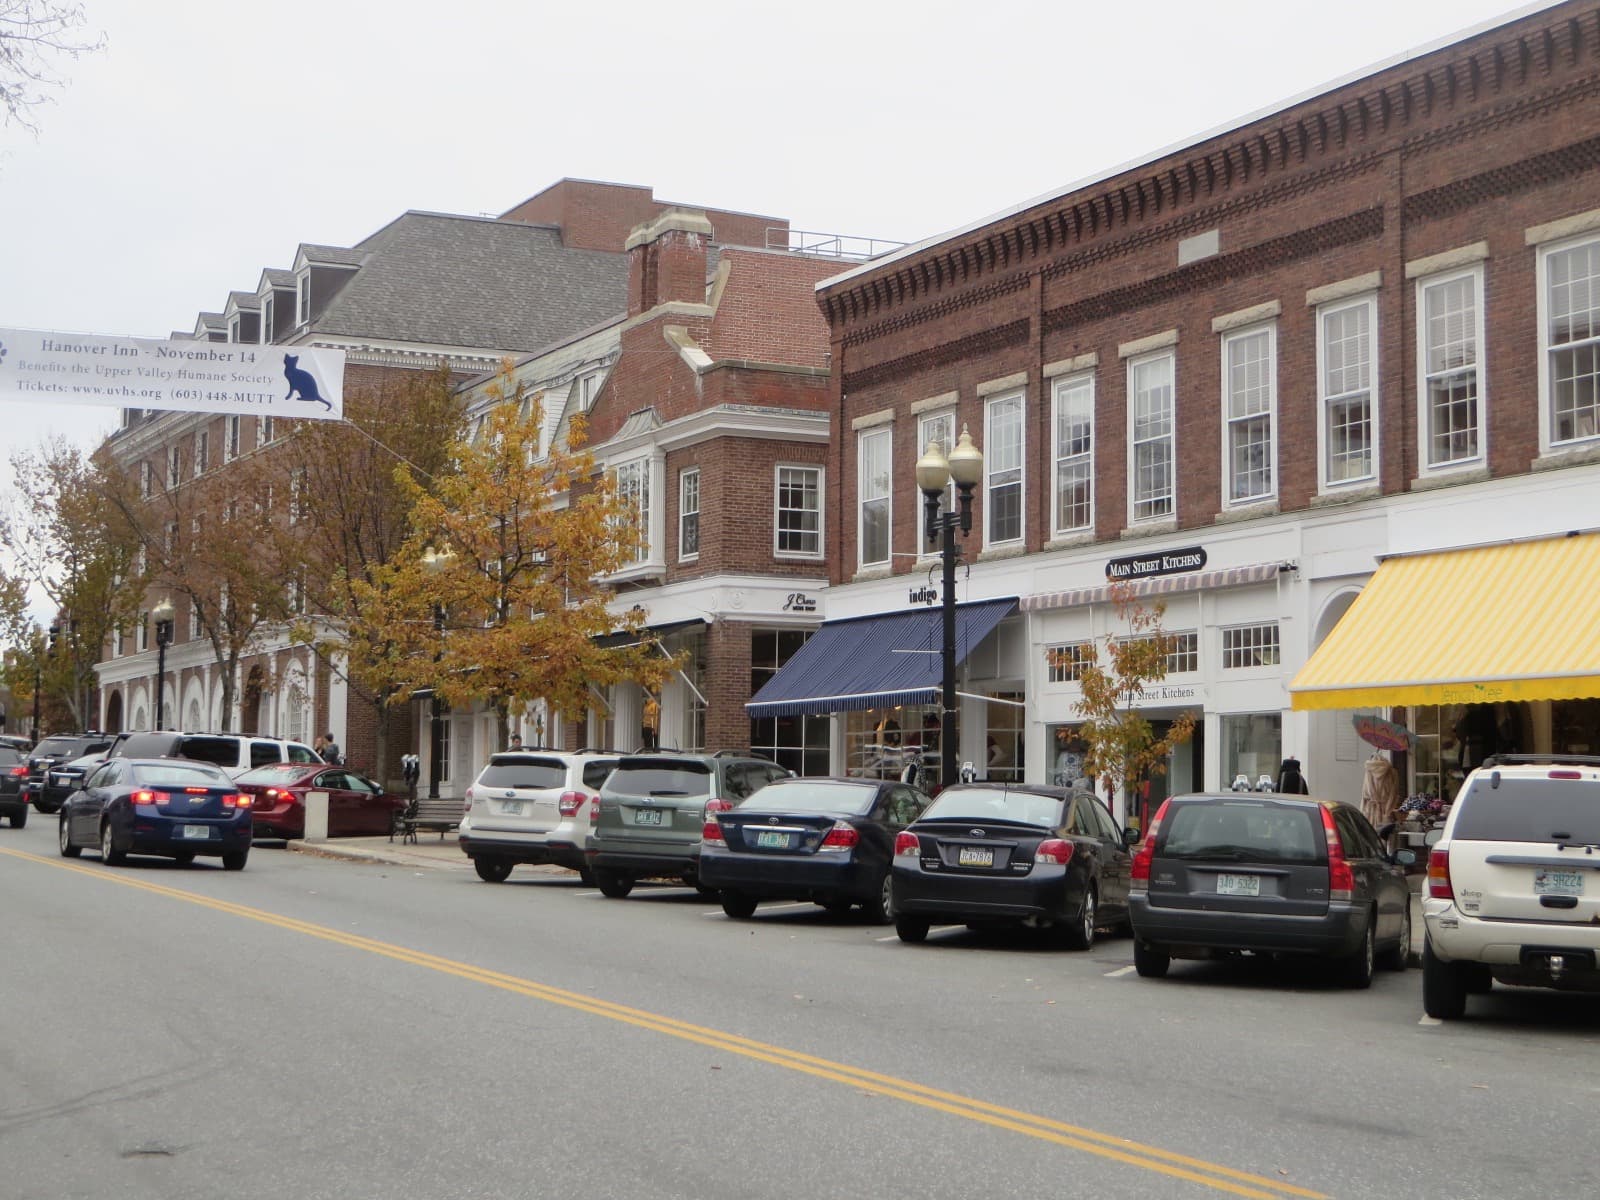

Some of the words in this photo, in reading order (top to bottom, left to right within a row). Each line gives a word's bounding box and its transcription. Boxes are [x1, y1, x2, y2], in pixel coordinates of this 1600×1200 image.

[42, 340, 107, 355] Hanover
[113, 344, 138, 356] Inn
[156, 347, 234, 362] November
[240, 351, 256, 363] 14
[18, 360, 67, 373] Benefits
[71, 363, 90, 374] the
[95, 364, 132, 378] Upper
[136, 367, 172, 380] Valley
[177, 369, 227, 382] Humane
[231, 372, 274, 386] Society
[17, 380, 68, 393] Tickets:
[72, 382, 162, 400] www.uvhs.org
[170, 388, 203, 401] (603)
[206, 391, 275, 404] 448-MUTT
[1162, 553, 1201, 570] KITCHENS
[909, 586, 937, 605] indigo
[1137, 688, 1159, 701] Street
[1162, 686, 1195, 699] Kitchens
